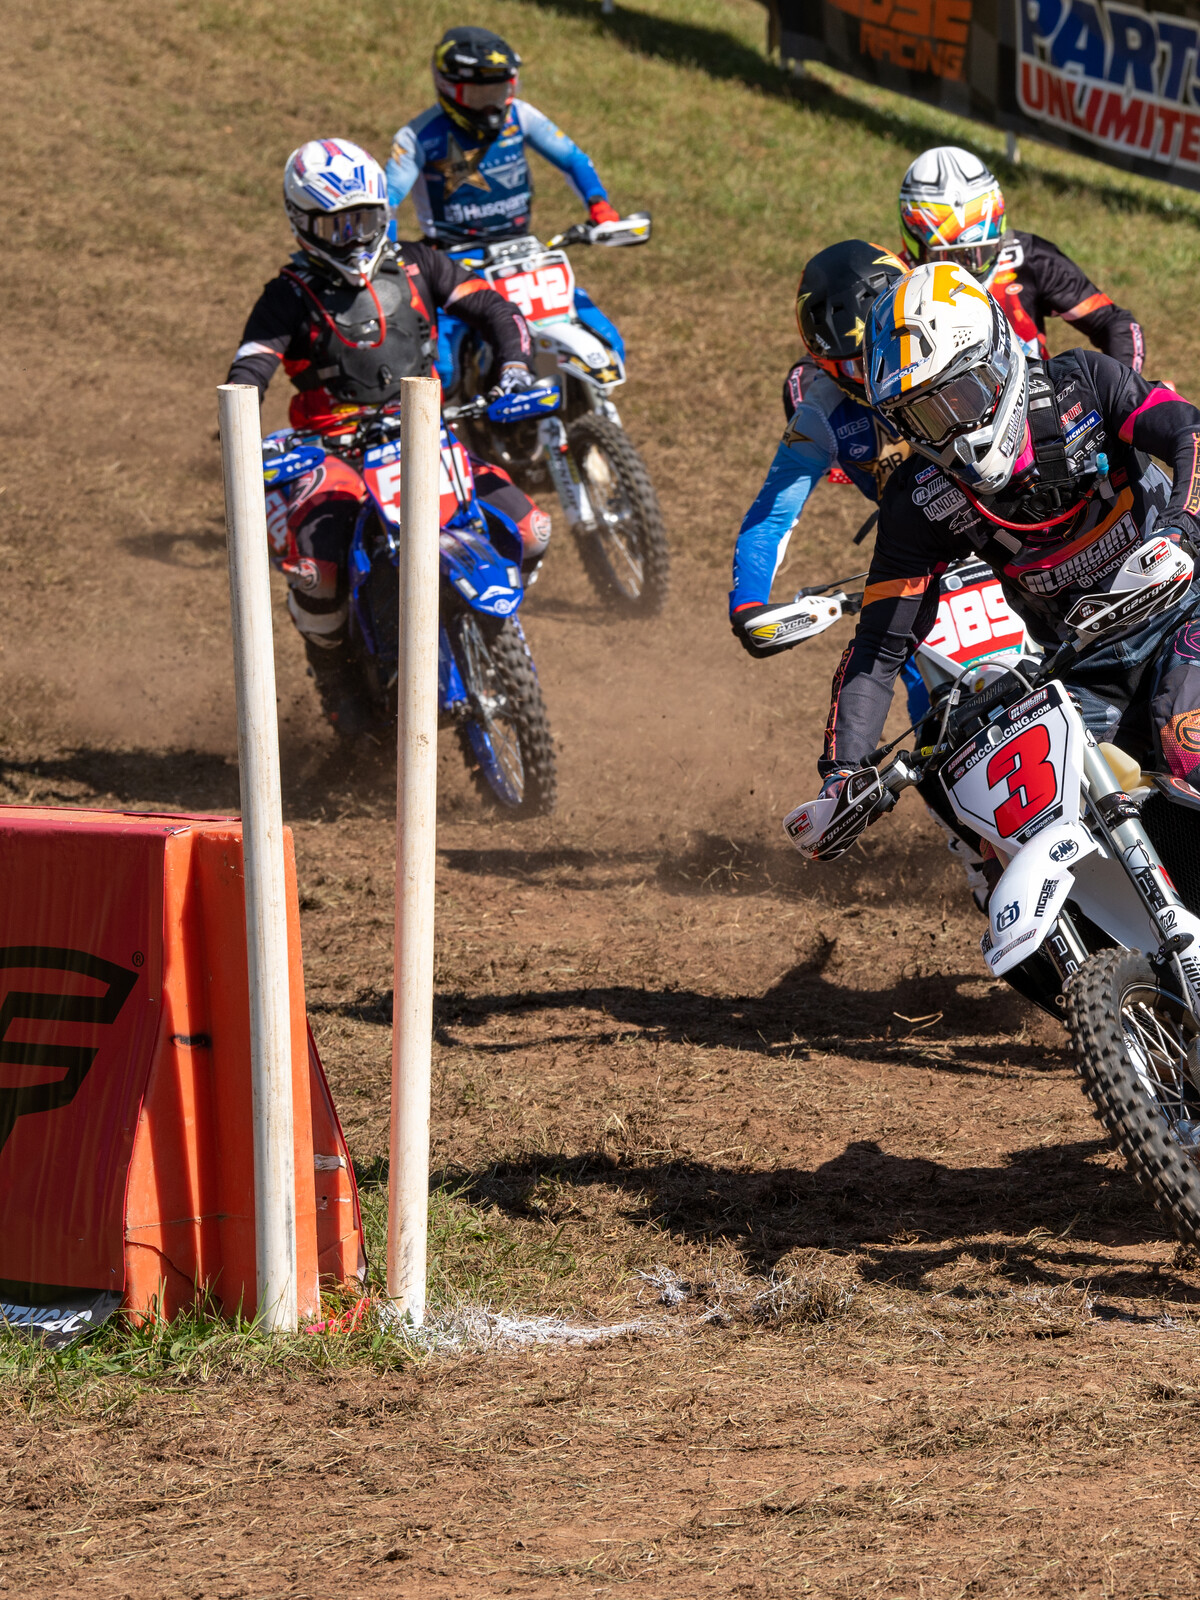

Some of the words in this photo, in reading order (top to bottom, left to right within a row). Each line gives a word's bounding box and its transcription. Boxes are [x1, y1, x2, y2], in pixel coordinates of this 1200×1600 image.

[859, 23, 967, 82] RACING
[505, 266, 570, 316] 342
[837, 417, 870, 439] WPS
[376, 446, 473, 524] 54
[1122, 563, 1187, 615] G2ergo.com
[964, 703, 1052, 770] GNCCACING.COM
[987, 723, 1057, 839] 3
[1050, 838, 1076, 862] FMF
